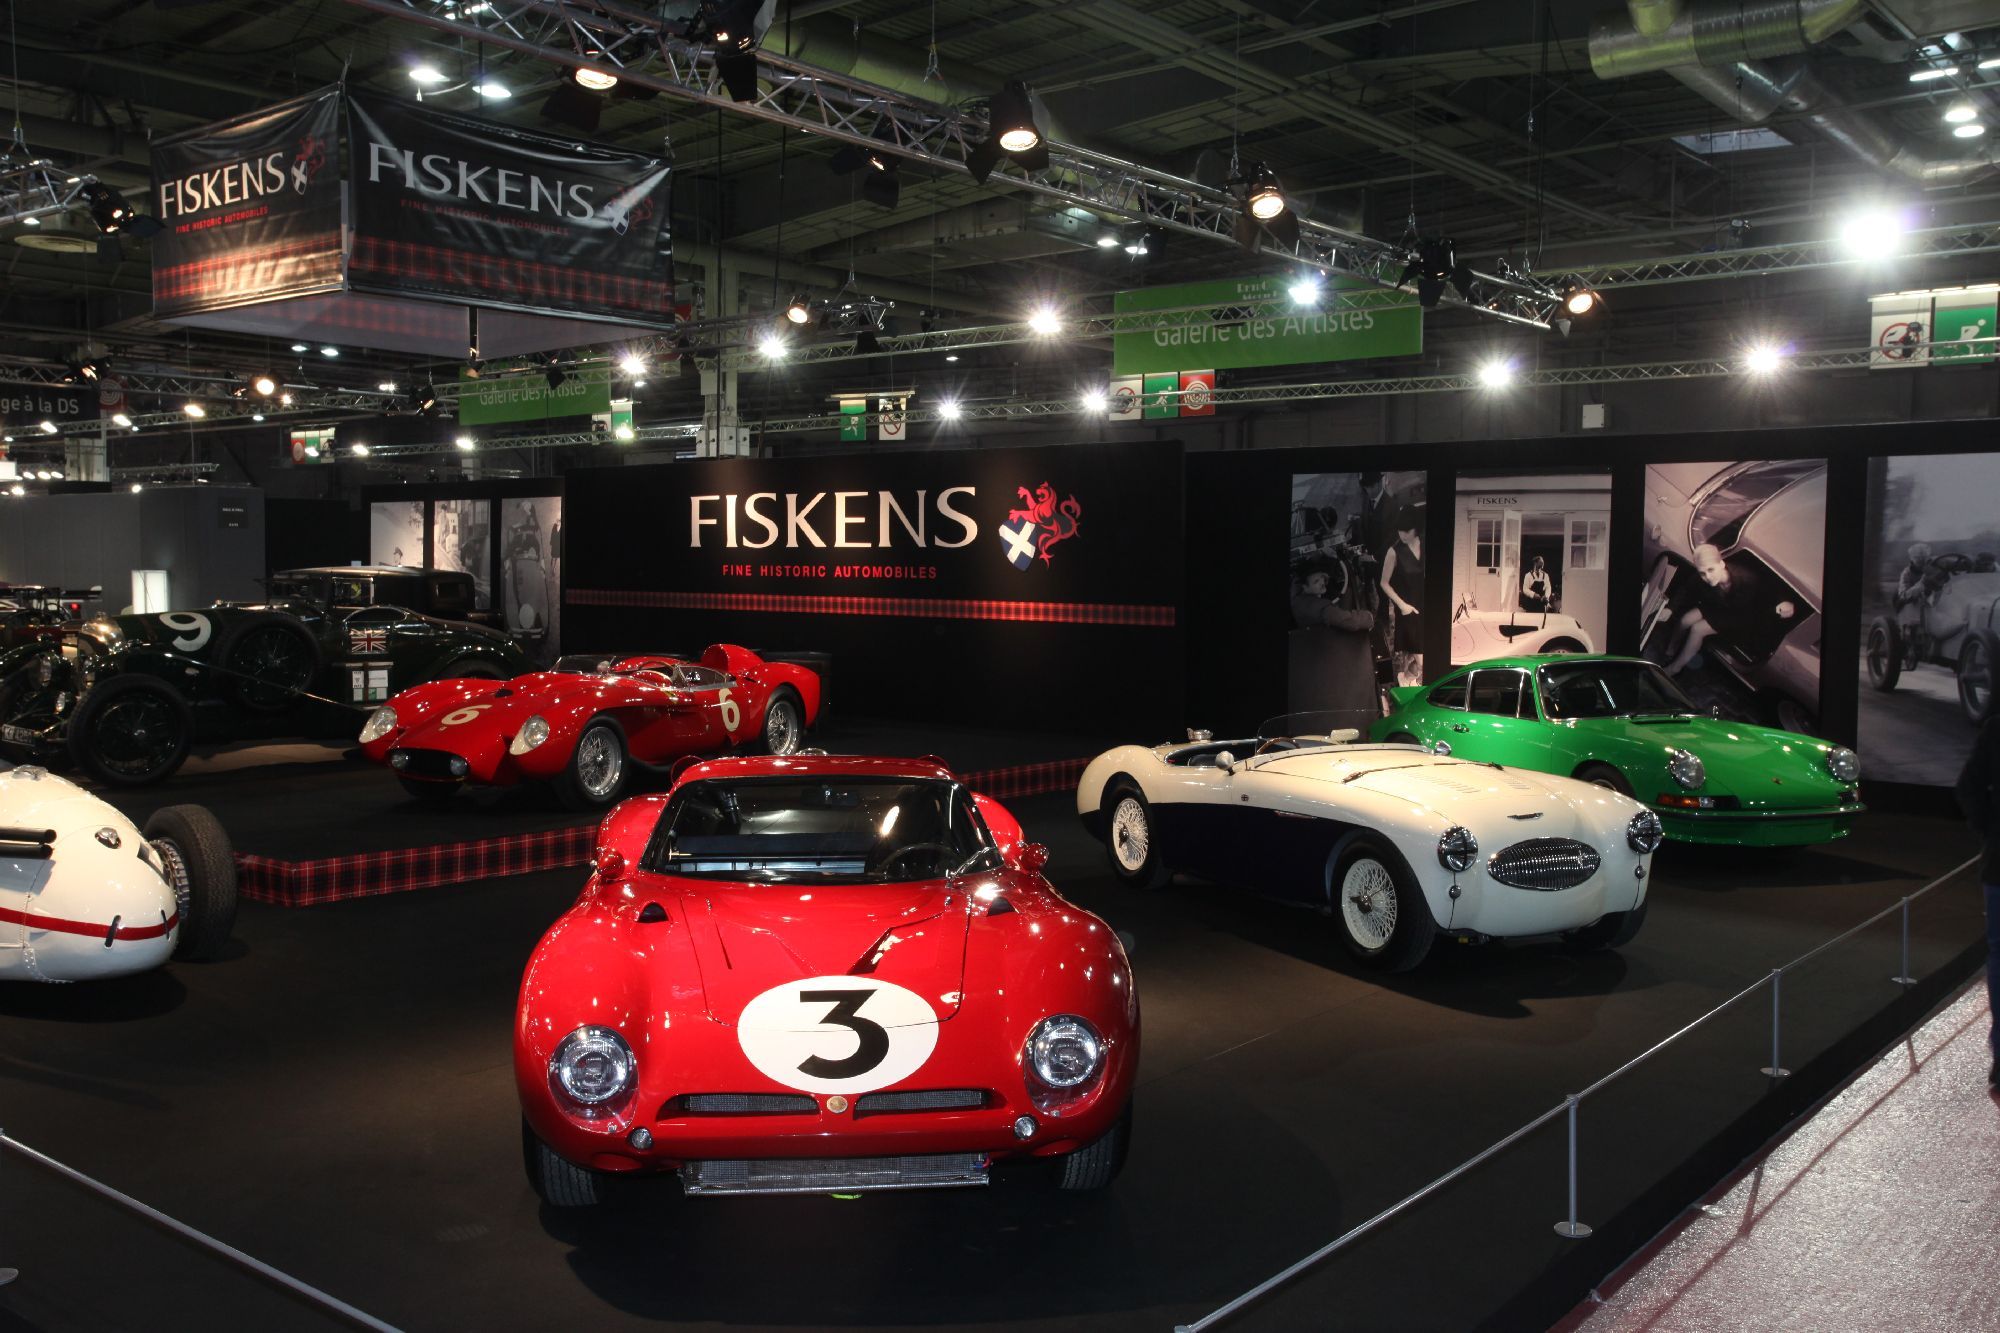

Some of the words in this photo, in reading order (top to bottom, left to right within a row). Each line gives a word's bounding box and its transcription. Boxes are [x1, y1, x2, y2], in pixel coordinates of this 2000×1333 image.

[160, 152, 285, 219] FISKENS
[369, 142, 594, 221] FISKENS
[175, 224, 190, 234] FINE
[192, 216, 222, 231] HISTORIC
[224, 205, 268, 223] AUTOMOBILES
[401, 199, 429, 212] FINE
[435, 205, 490, 221] HISTORIC
[496, 215, 570, 237] AUTOMOBILES
[1154, 319, 1230, 347] Galerie
[1238, 315, 1275, 341] des
[1283, 308, 1374, 337] Artistes
[24, 395, 33, 412] à
[39, 397, 52, 413] la
[58, 399, 79, 414] DS
[479, 385, 519, 406] Galerie
[521, 382, 540, 401] des
[690, 486, 978, 549] FISKENS
[1477, 496, 1518, 505] FISKENS
[722, 564, 753, 577] FINE
[760, 565, 826, 578] HISTORIC
[834, 565, 937, 579] AUTOMOBILES
[159, 611, 211, 652] 9
[441, 704, 492, 726] 6
[720, 688, 741, 732] 6
[797, 988, 889, 1079] 3
